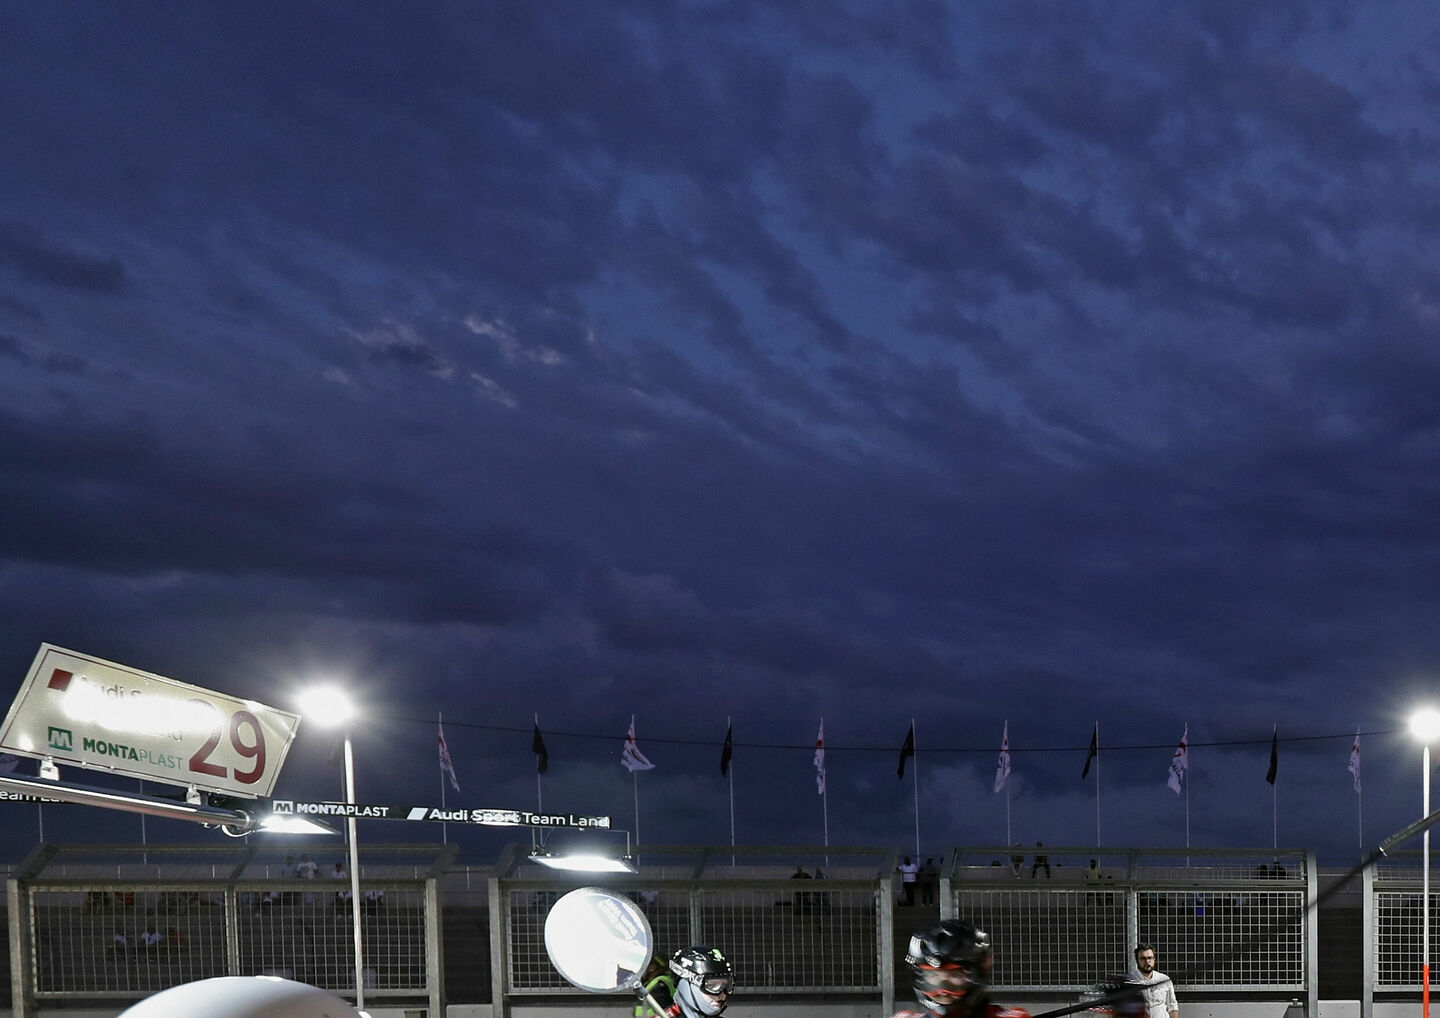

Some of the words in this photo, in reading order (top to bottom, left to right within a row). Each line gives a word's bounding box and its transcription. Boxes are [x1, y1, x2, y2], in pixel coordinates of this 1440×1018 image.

[82, 737, 183, 771] MONTAPLAST
[188, 699, 266, 785] 29
[296, 803, 390, 817] MONTAPLAST
[429, 808, 468, 822] Audi
[522, 812, 564, 826] Team
